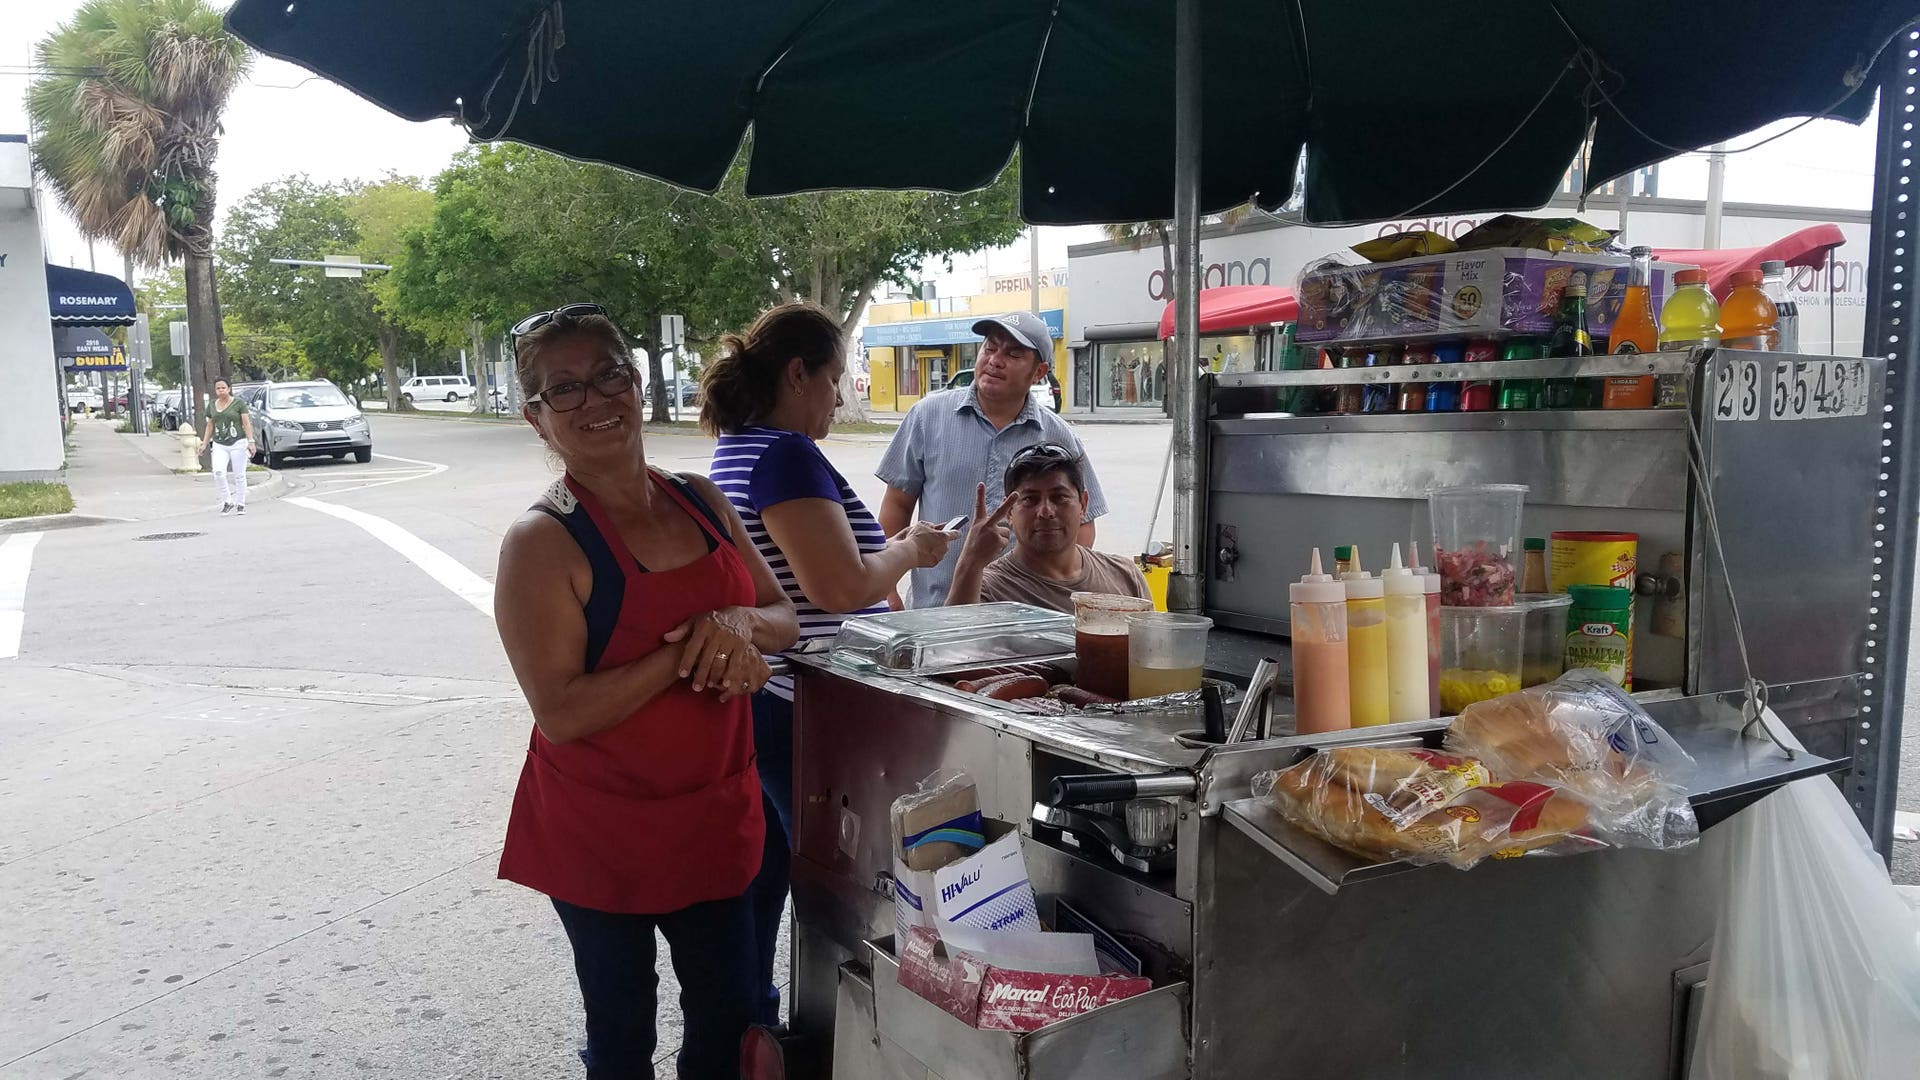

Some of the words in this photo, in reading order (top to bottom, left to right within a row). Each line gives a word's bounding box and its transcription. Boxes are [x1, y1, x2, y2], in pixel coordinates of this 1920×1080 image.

[1455, 260, 1487, 271] Flavor
[1461, 270, 1479, 281] Mix
[994, 275, 1049, 293] PERFUMS
[59, 295, 118, 306] ROSEMARY
[1459, 292, 1477, 306] 50
[1823, 295, 1866, 307] WOLESALE
[76, 345, 91, 353] EASY
[1717, 362, 1757, 417] 23
[1585, 624, 1610, 635] Kraft
[990, 908, 1025, 931] STRAW
[905, 940, 931, 959] Marcal
[987, 983, 1051, 1004] Marcal
